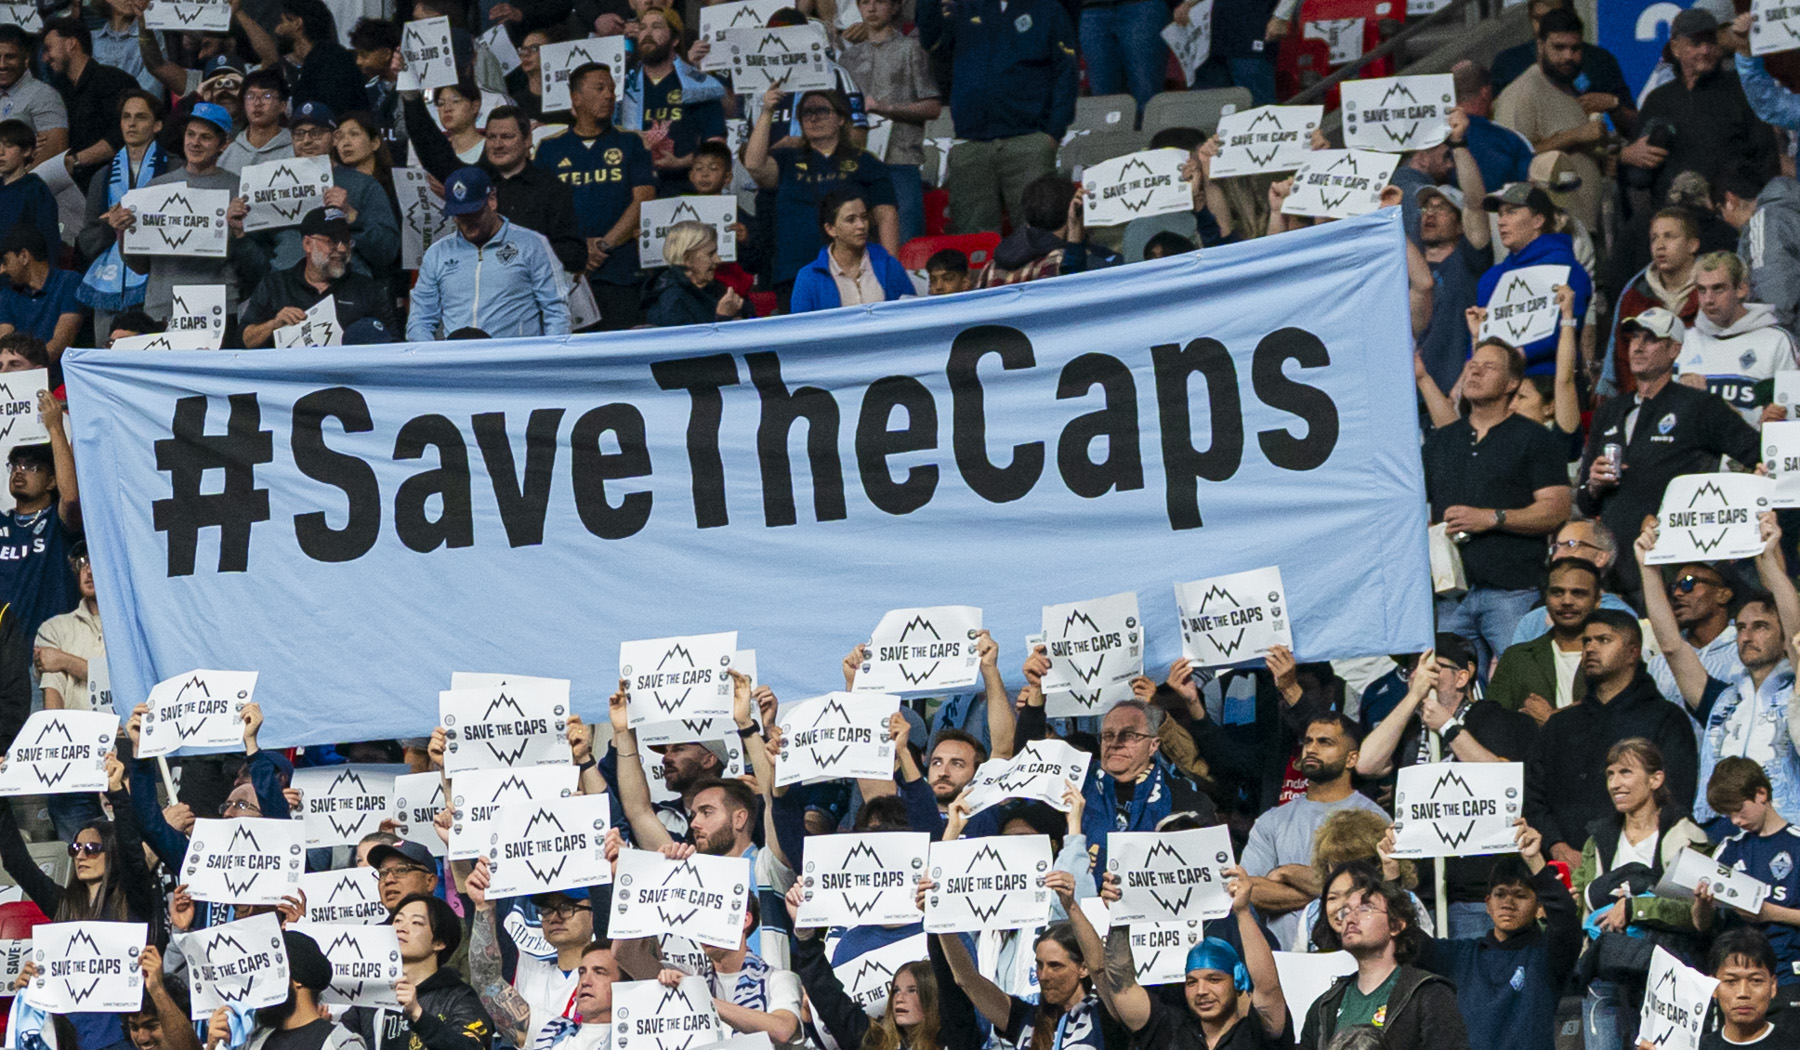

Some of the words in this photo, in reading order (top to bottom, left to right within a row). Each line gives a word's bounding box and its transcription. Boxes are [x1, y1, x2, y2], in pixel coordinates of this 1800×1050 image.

[1363, 108, 1389, 123] SAVE
[1391, 108, 1406, 118] THE
[1407, 104, 1436, 119] CAPS
[1230, 133, 1253, 146] SAVE
[1256, 133, 1268, 141] THE
[1270, 130, 1297, 142] CAPS
[142, 213, 166, 226] SAVE
[168, 216, 181, 225] THE
[183, 215, 209, 227] CAPS
[152, 324, 1340, 578] #SaveTheCaps
[1669, 511, 1696, 527] SAVE
[1699, 511, 1714, 523] THE
[1717, 508, 1747, 524] CAPS
[880, 645, 908, 661] SAVE
[911, 646, 926, 657] THE
[929, 642, 959, 658] CAPS
[463, 723, 494, 740] SAVE
[495, 723, 512, 735] THE
[514, 718, 547, 735] CAPS
[1411, 802, 1440, 819] SAVE
[1442, 803, 1459, 815] THE
[1462, 799, 1495, 816] CAPS
[505, 840, 533, 858] SAVE
[536, 839, 552, 852] THE
[554, 833, 586, 852] CAPS
[822, 872, 851, 889] SAVE
[854, 874, 870, 885] THE
[873, 871, 903, 887] CAPS
[638, 888, 667, 903] SAVE
[671, 888, 686, 899] THE
[688, 889, 723, 909] CAPS
